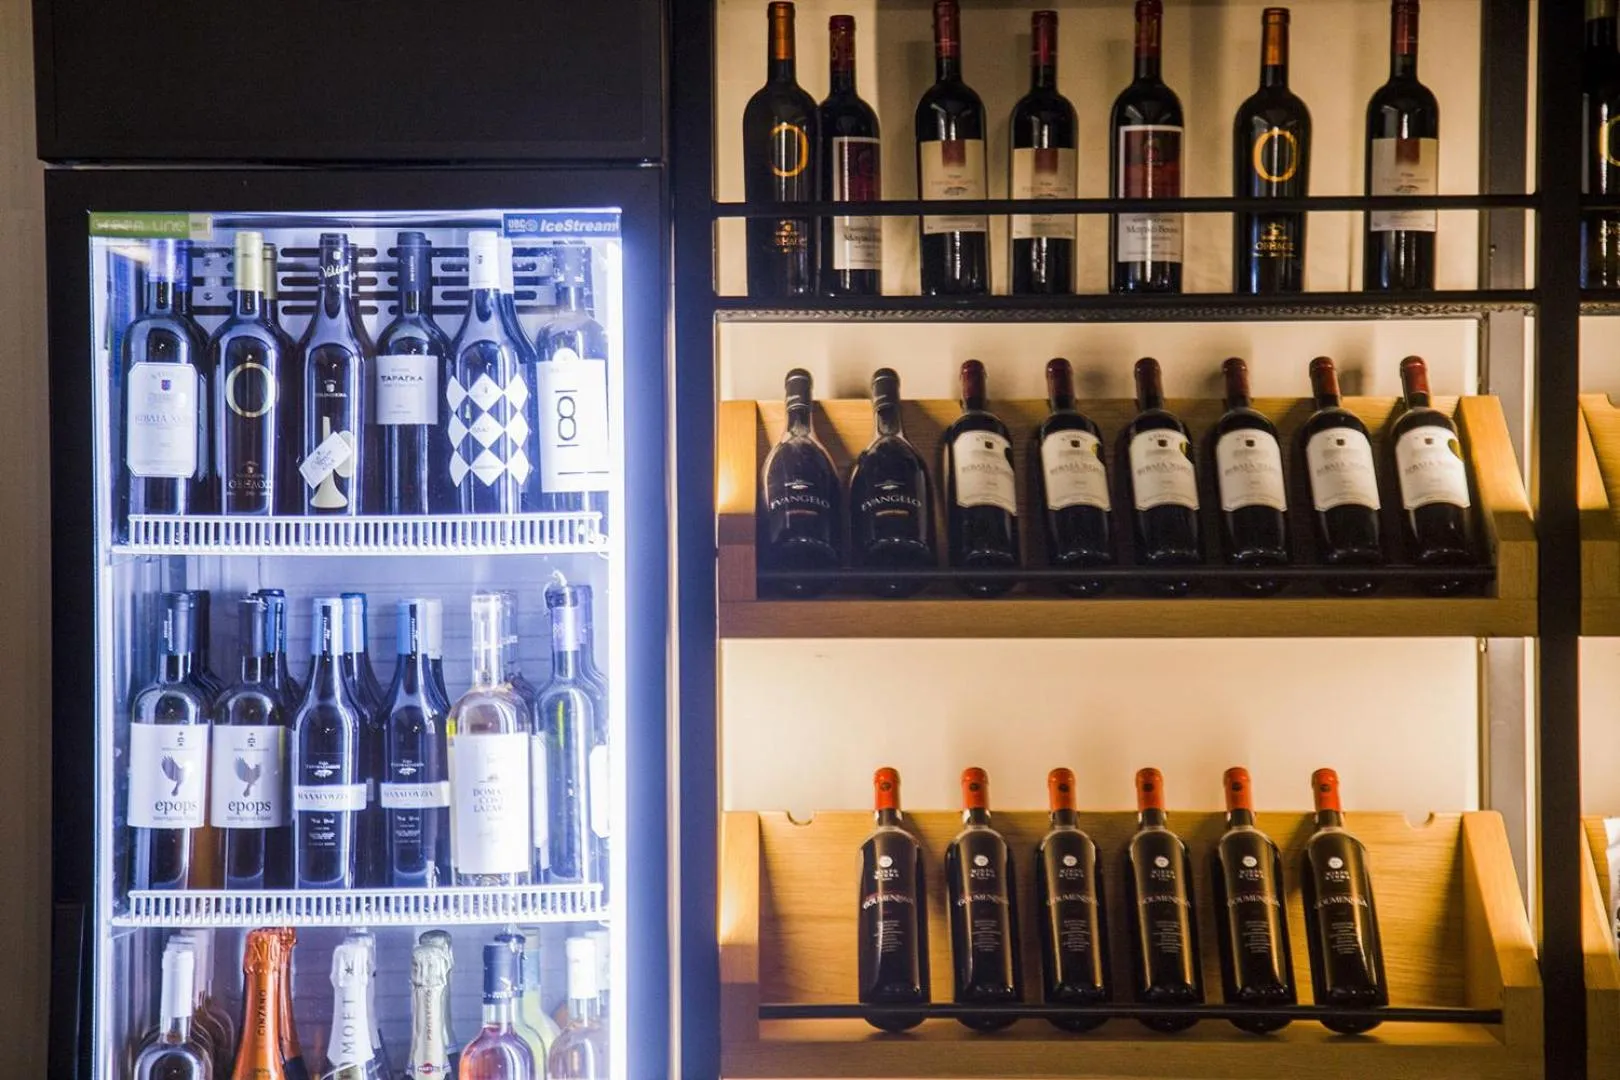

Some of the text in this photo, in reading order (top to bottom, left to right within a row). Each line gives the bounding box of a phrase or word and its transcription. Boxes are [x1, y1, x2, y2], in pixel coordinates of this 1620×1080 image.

[540, 219, 617, 233] IceStream
[154, 799, 198, 814] epops
[227, 799, 272, 814] epops
